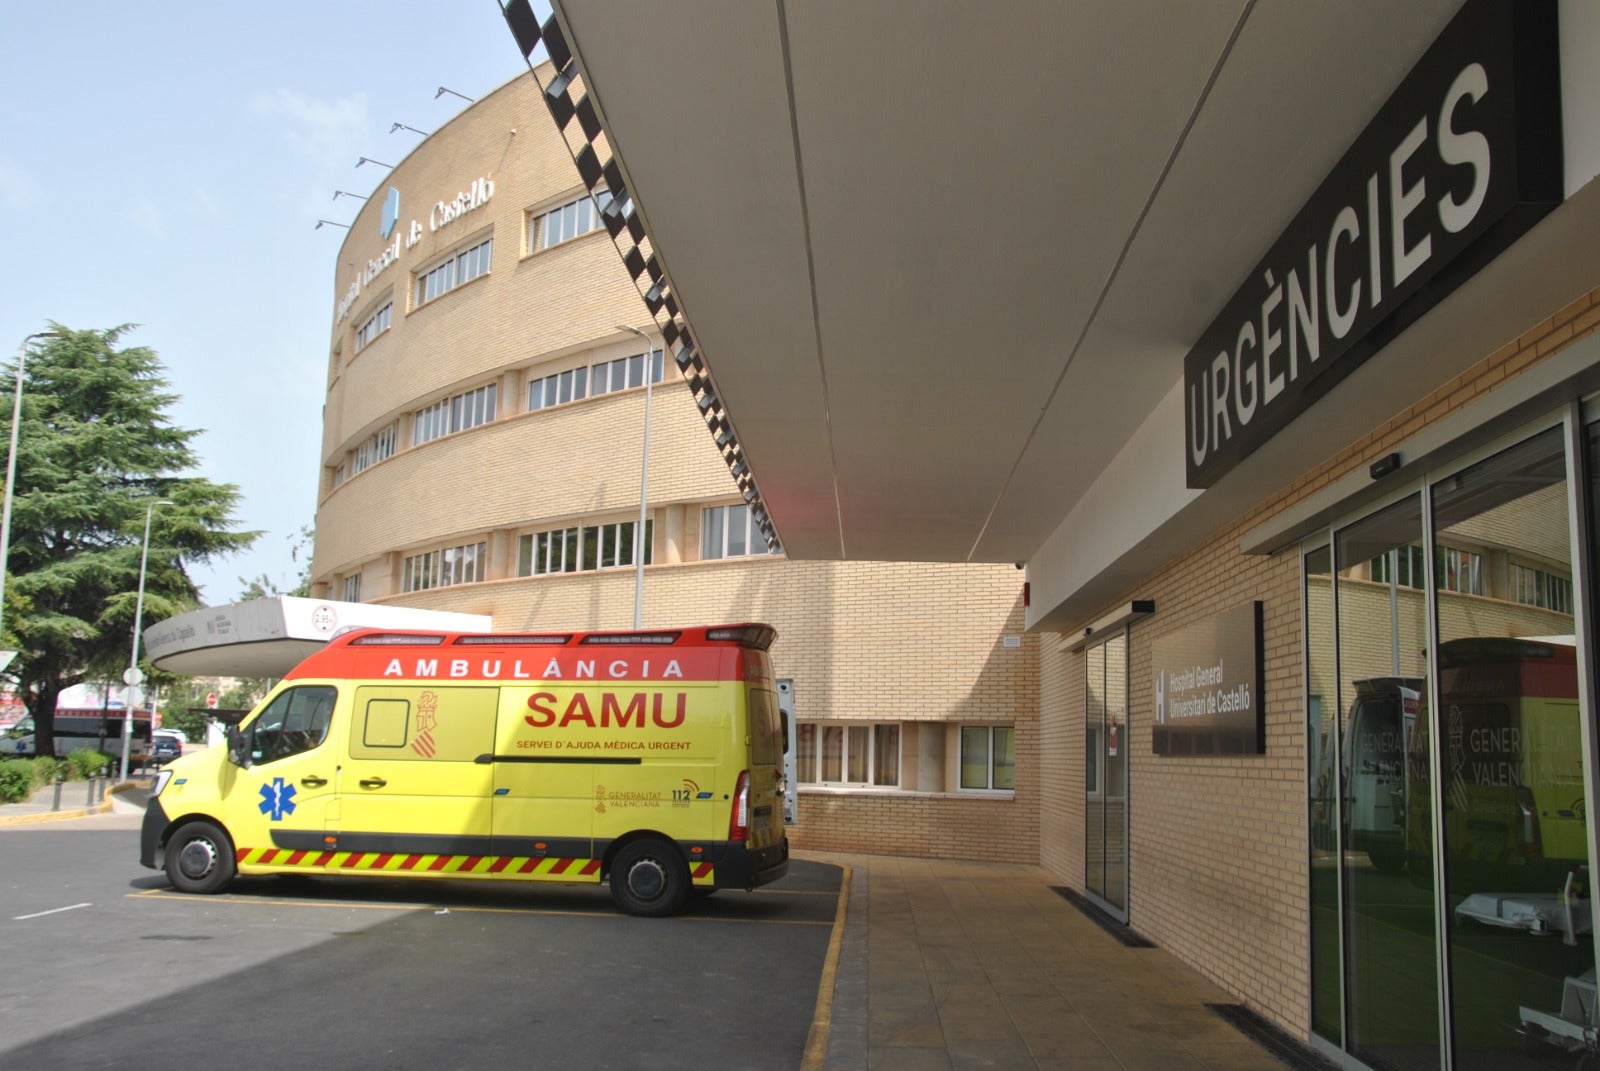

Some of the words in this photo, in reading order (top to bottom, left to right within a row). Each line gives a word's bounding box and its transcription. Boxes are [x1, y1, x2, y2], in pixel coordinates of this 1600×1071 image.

[1191, 62, 1491, 467] URGÈNCIES
[384, 657, 683, 678] AMBULÀNCIA
[1170, 666, 1195, 696] Hospital
[1196, 658, 1223, 688] General
[524, 692, 687, 729] SAMU
[1170, 692, 1206, 719] Universitari
[1206, 690, 1216, 714] de
[1217, 683, 1250, 713] Castelló
[516, 740, 553, 749] SERVEI
[604, 739, 645, 750] MÈDICA
[648, 741, 692, 751] URGENT
[608, 792, 661, 800] GENERALITAT
[672, 790, 690, 800] 112
